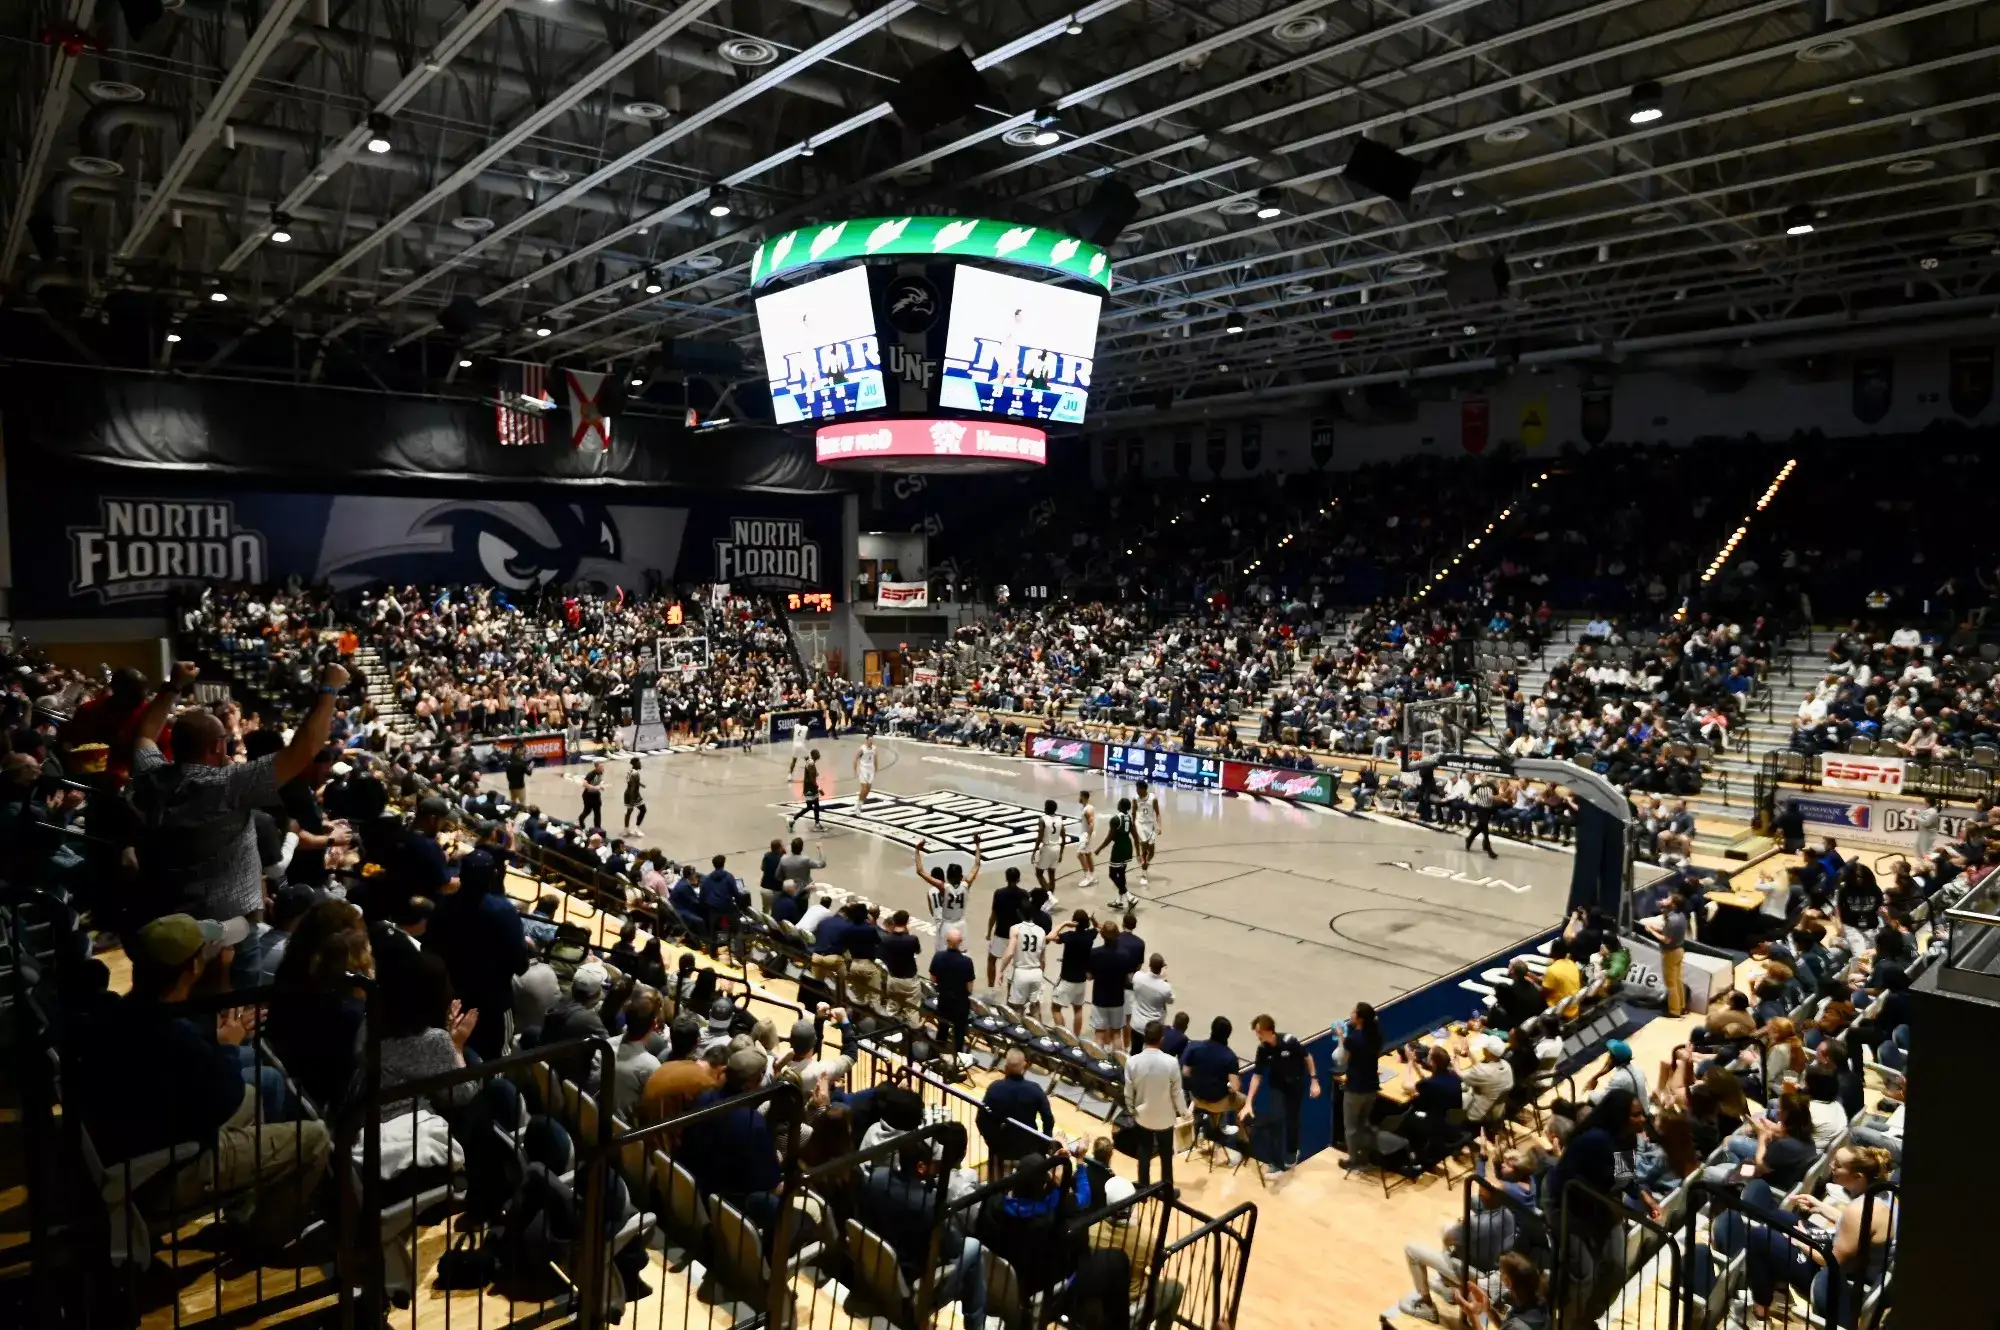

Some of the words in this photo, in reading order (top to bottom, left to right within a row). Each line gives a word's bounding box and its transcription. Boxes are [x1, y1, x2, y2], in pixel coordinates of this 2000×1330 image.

[889, 346, 938, 389] UNF
[106, 501, 229, 539] NORTH
[734, 520, 804, 547] NORTH
[77, 531, 263, 588] FLORIDA
[717, 543, 818, 583] FLORIDA
[881, 587, 925, 601] ESPN
[1825, 761, 1902, 785] ESPN
[947, 893, 964, 909] 24
[1022, 934, 1037, 953] 33
